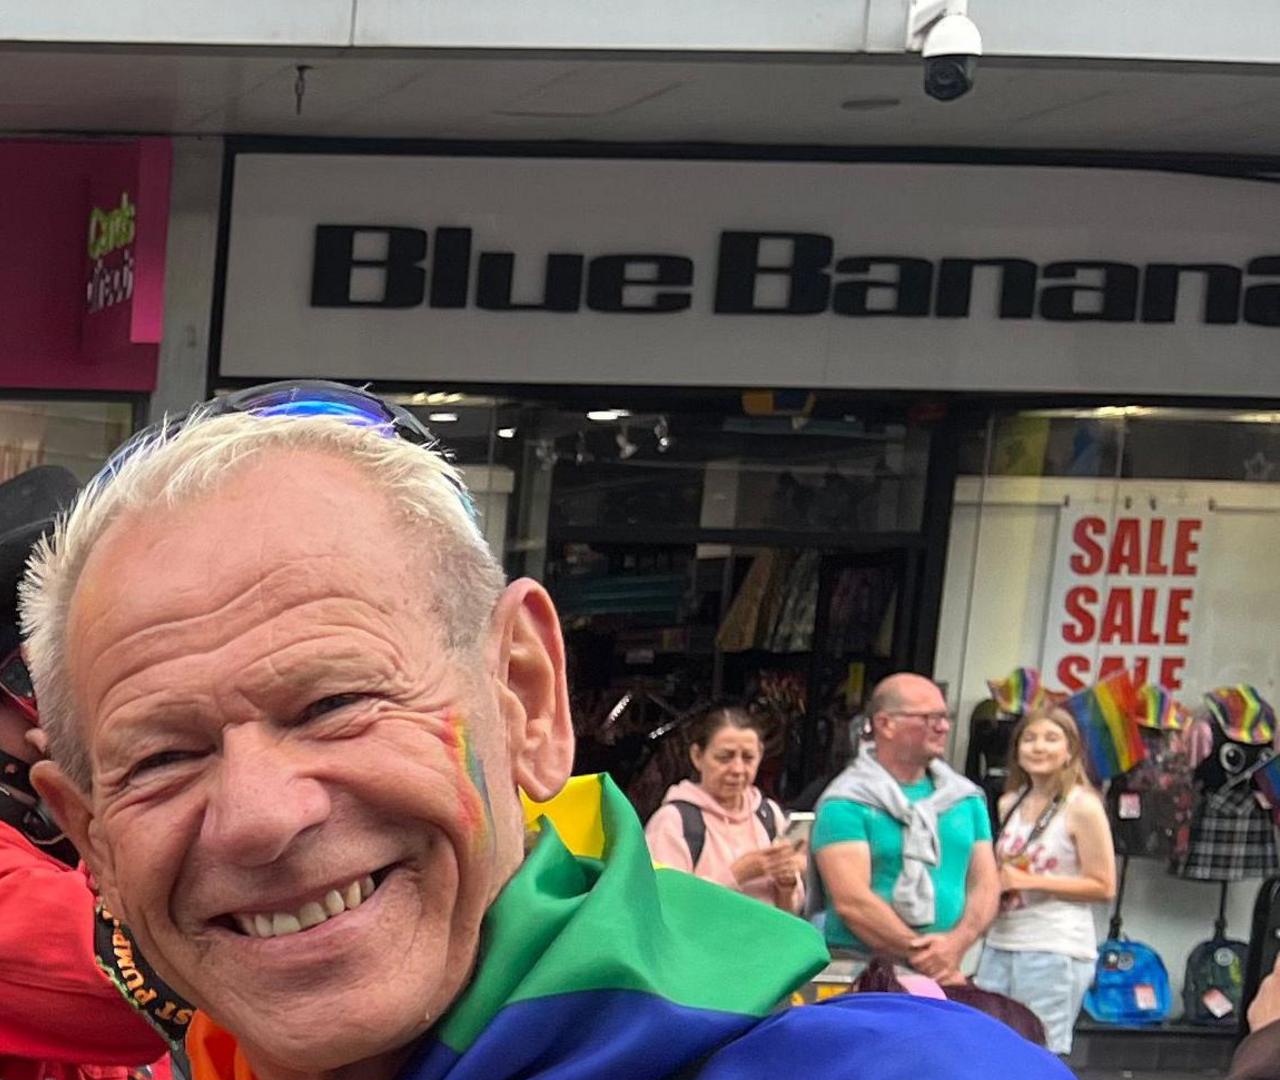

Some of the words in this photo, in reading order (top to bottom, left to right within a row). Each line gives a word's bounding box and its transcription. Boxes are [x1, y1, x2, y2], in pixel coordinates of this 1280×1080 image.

[310, 224, 695, 313] Blue
[1070, 515, 1203, 576] SALE
[1061, 585, 1195, 644] SALE
